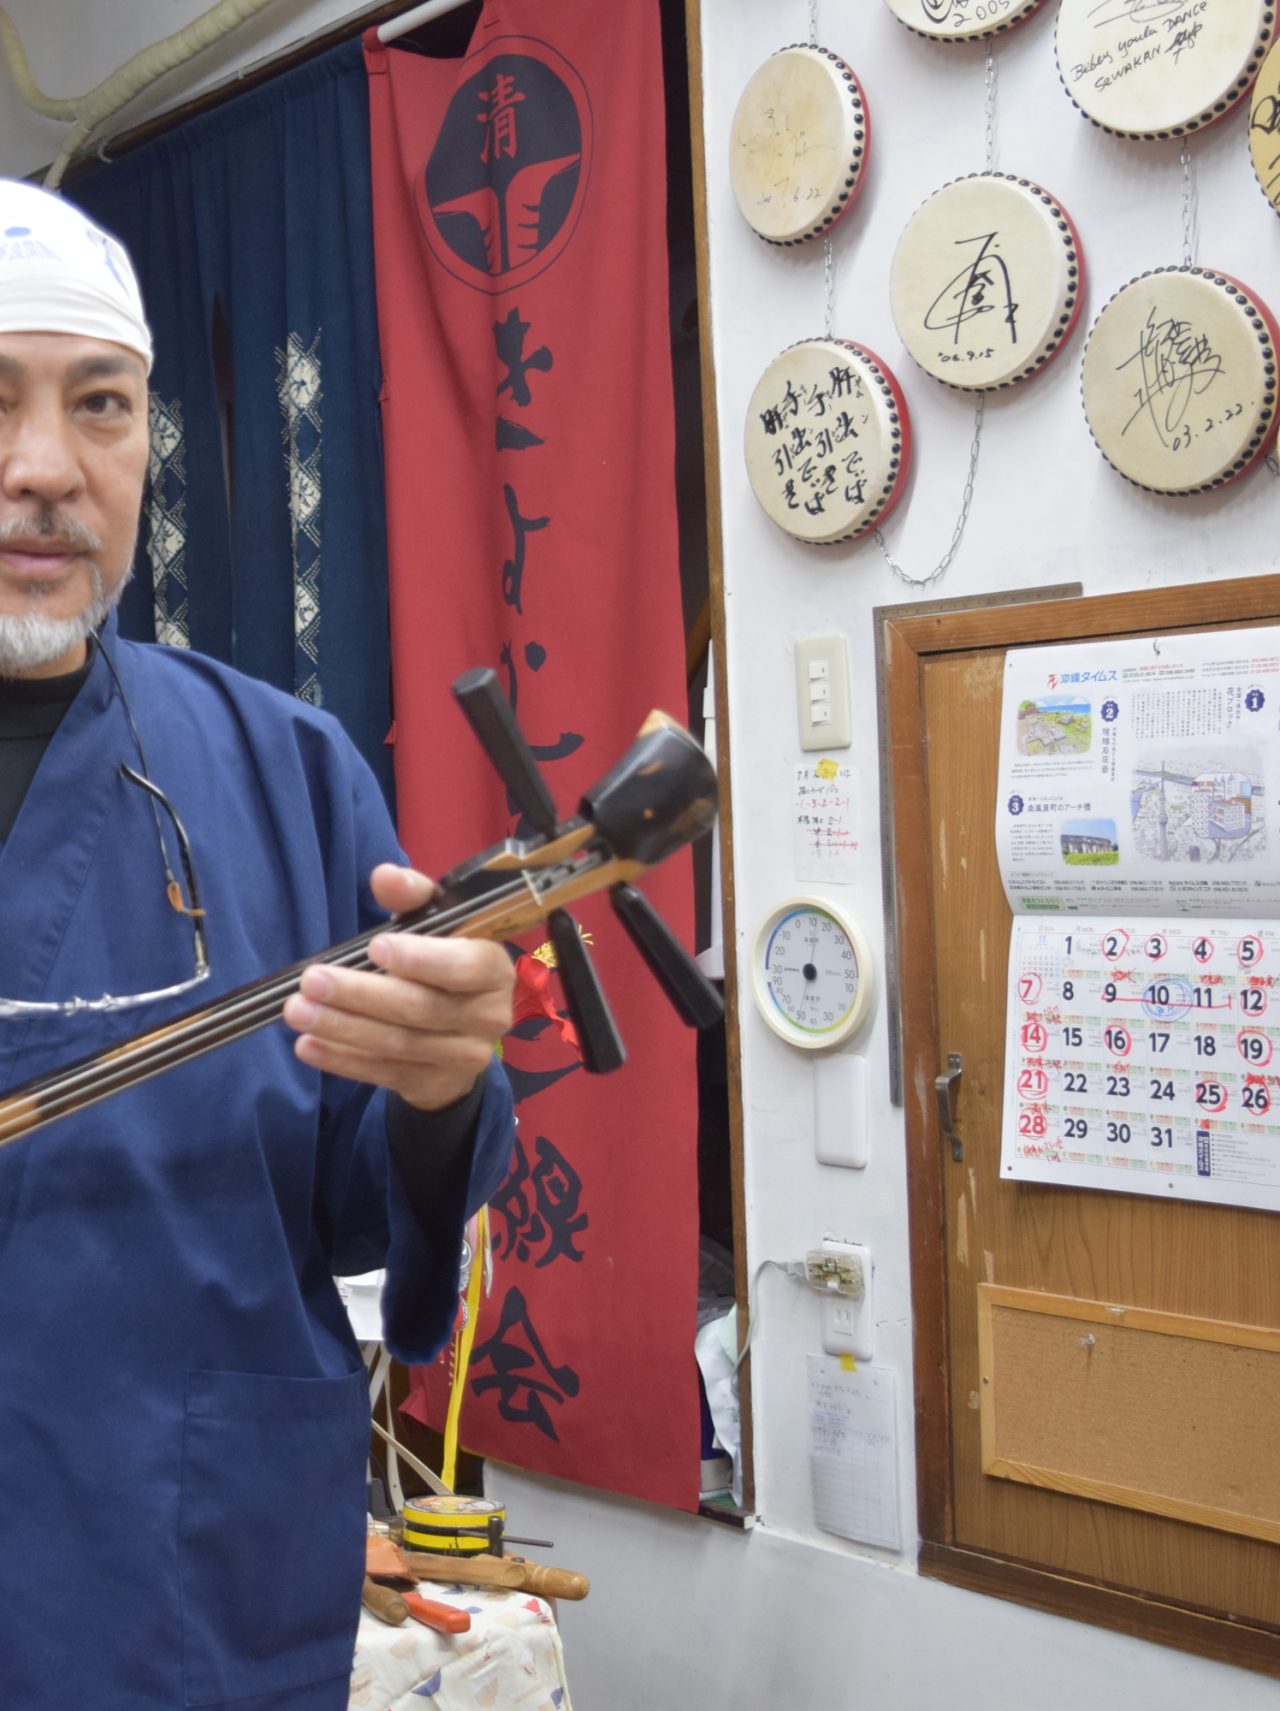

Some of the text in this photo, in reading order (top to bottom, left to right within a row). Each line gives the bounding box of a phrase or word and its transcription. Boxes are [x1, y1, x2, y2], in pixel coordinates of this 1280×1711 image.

[476, 73, 526, 161] 清
[1059, 669, 1118, 684] 沖縄タイムス
[1065, 935, 1255, 961] 1 2 3 4 5
[1020, 979, 1263, 1011] 7 8 9 10 11 12
[1021, 1024, 1263, 1060] 14 15 16 17 18 19
[1020, 1069, 1268, 1109] 21 22 23 24 25 26
[1019, 1114, 1173, 1148] 28 29 30 31
